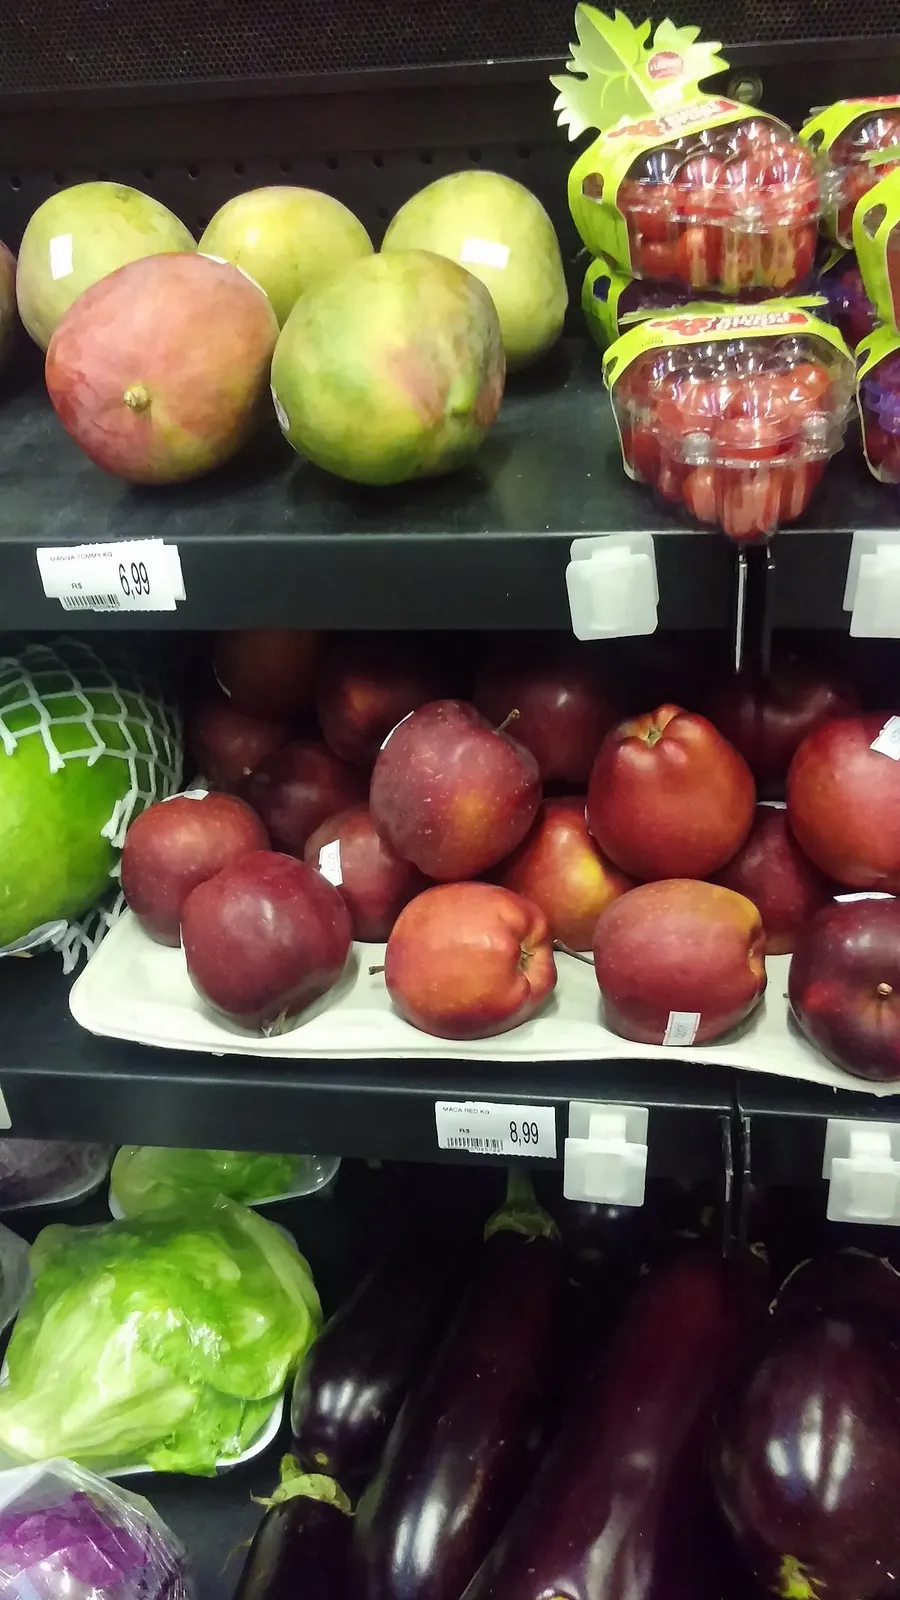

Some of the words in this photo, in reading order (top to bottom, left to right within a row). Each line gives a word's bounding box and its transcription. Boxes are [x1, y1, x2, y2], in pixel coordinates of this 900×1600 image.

[49, 553, 75, 562] MANGA
[77, 552, 102, 560] TOMMY
[71, 582, 83, 590] R$
[118, 561, 150, 600] 6,99
[509, 1120, 539, 1147] 8,99
